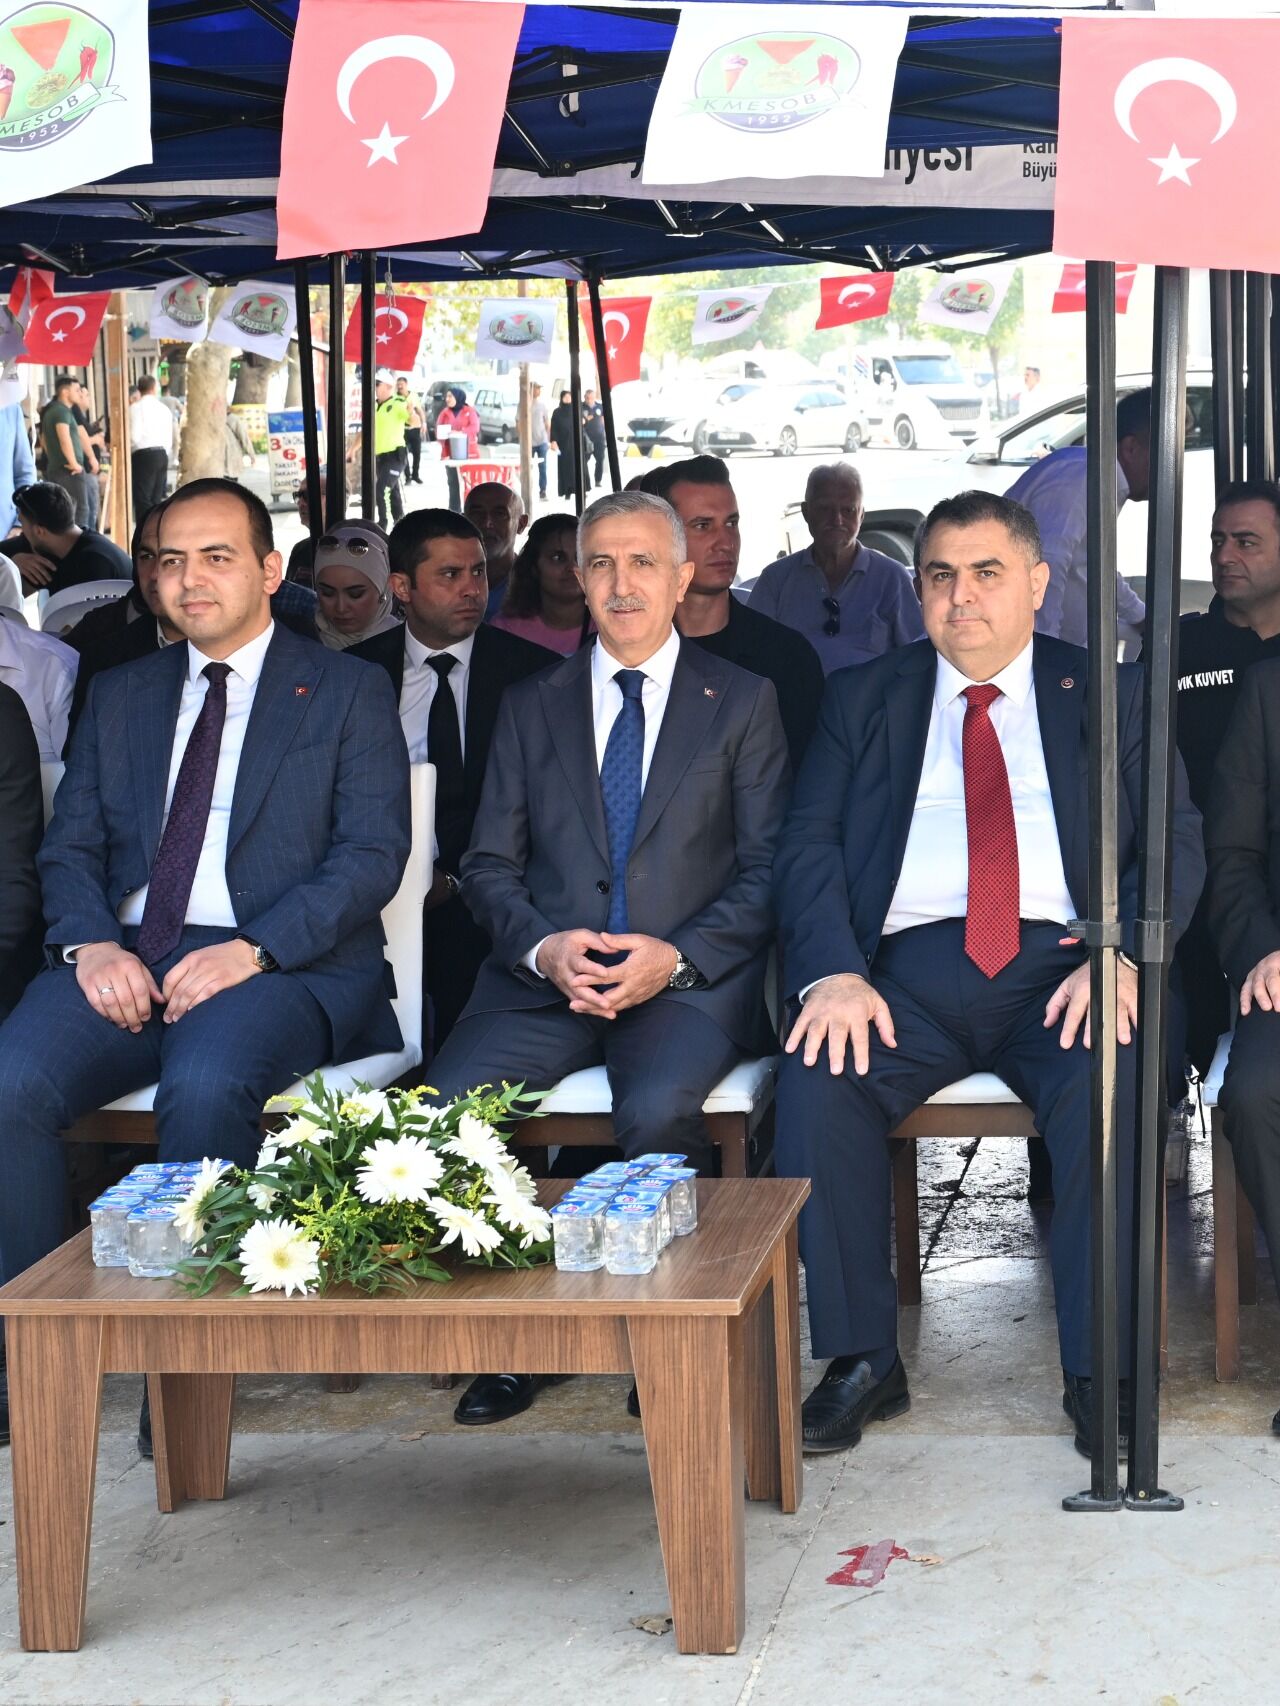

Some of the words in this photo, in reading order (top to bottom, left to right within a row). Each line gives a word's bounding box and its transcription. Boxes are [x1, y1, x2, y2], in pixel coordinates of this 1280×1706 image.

[704, 94, 817, 111] KMESOB
[0, 95, 79, 135] MESOB
[746, 114, 792, 125] 1952
[20, 124, 59, 143] 1952
[1195, 669, 1234, 687] KUVVET
